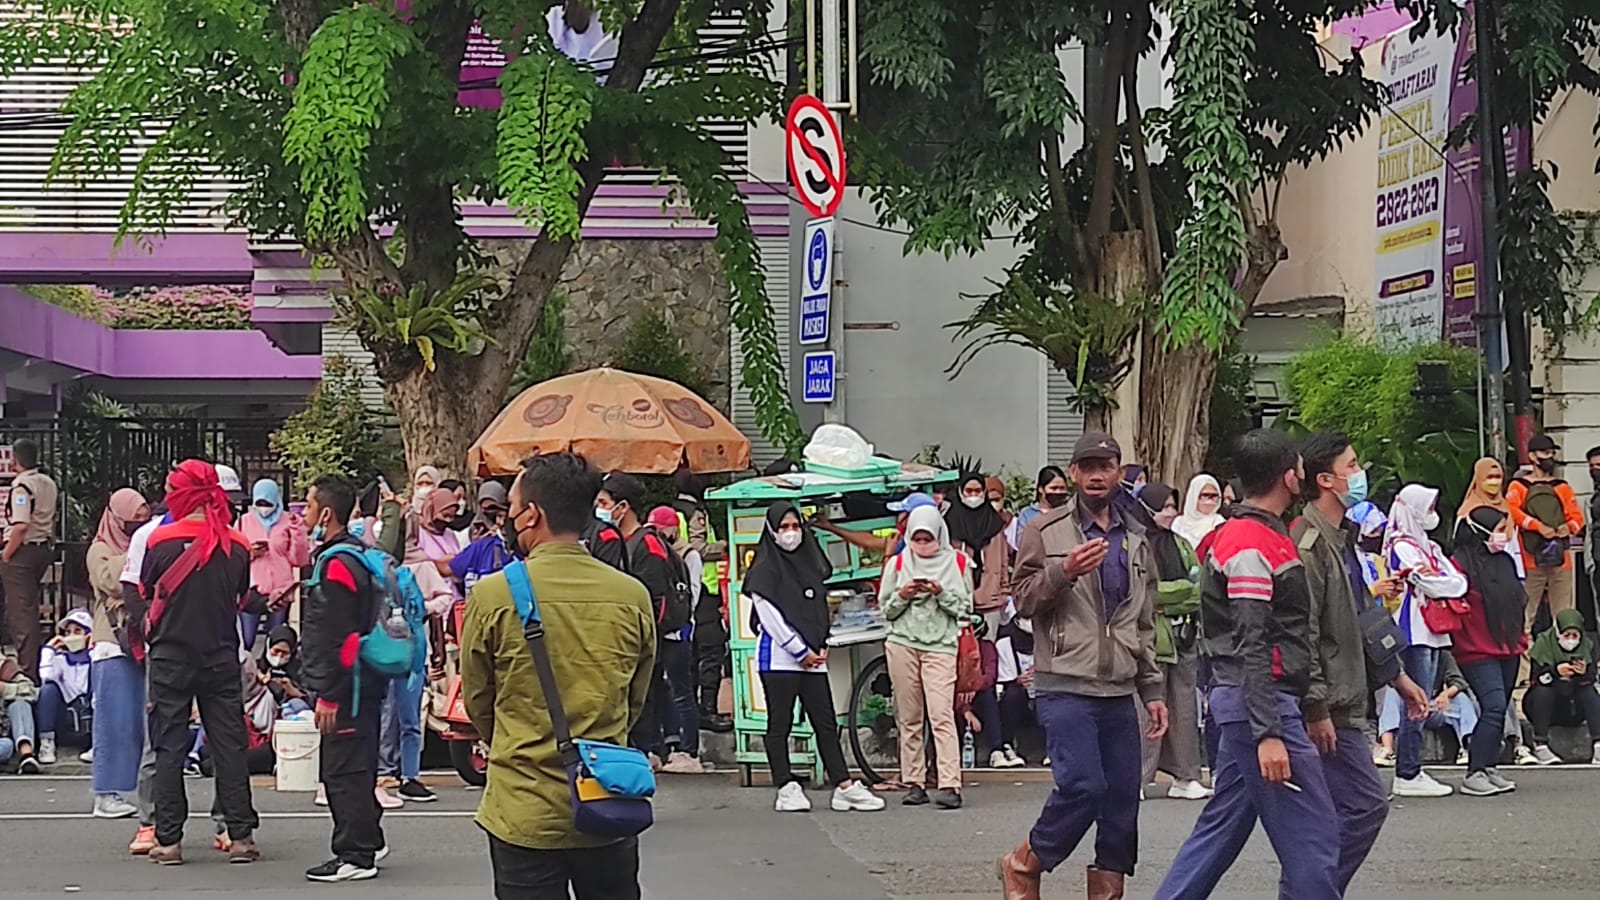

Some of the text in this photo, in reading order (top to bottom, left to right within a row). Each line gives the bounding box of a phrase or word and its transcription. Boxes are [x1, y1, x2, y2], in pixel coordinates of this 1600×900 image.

[799, 117, 832, 194] S
[809, 359, 829, 375] JAGA
[807, 378, 831, 394] JARAK
